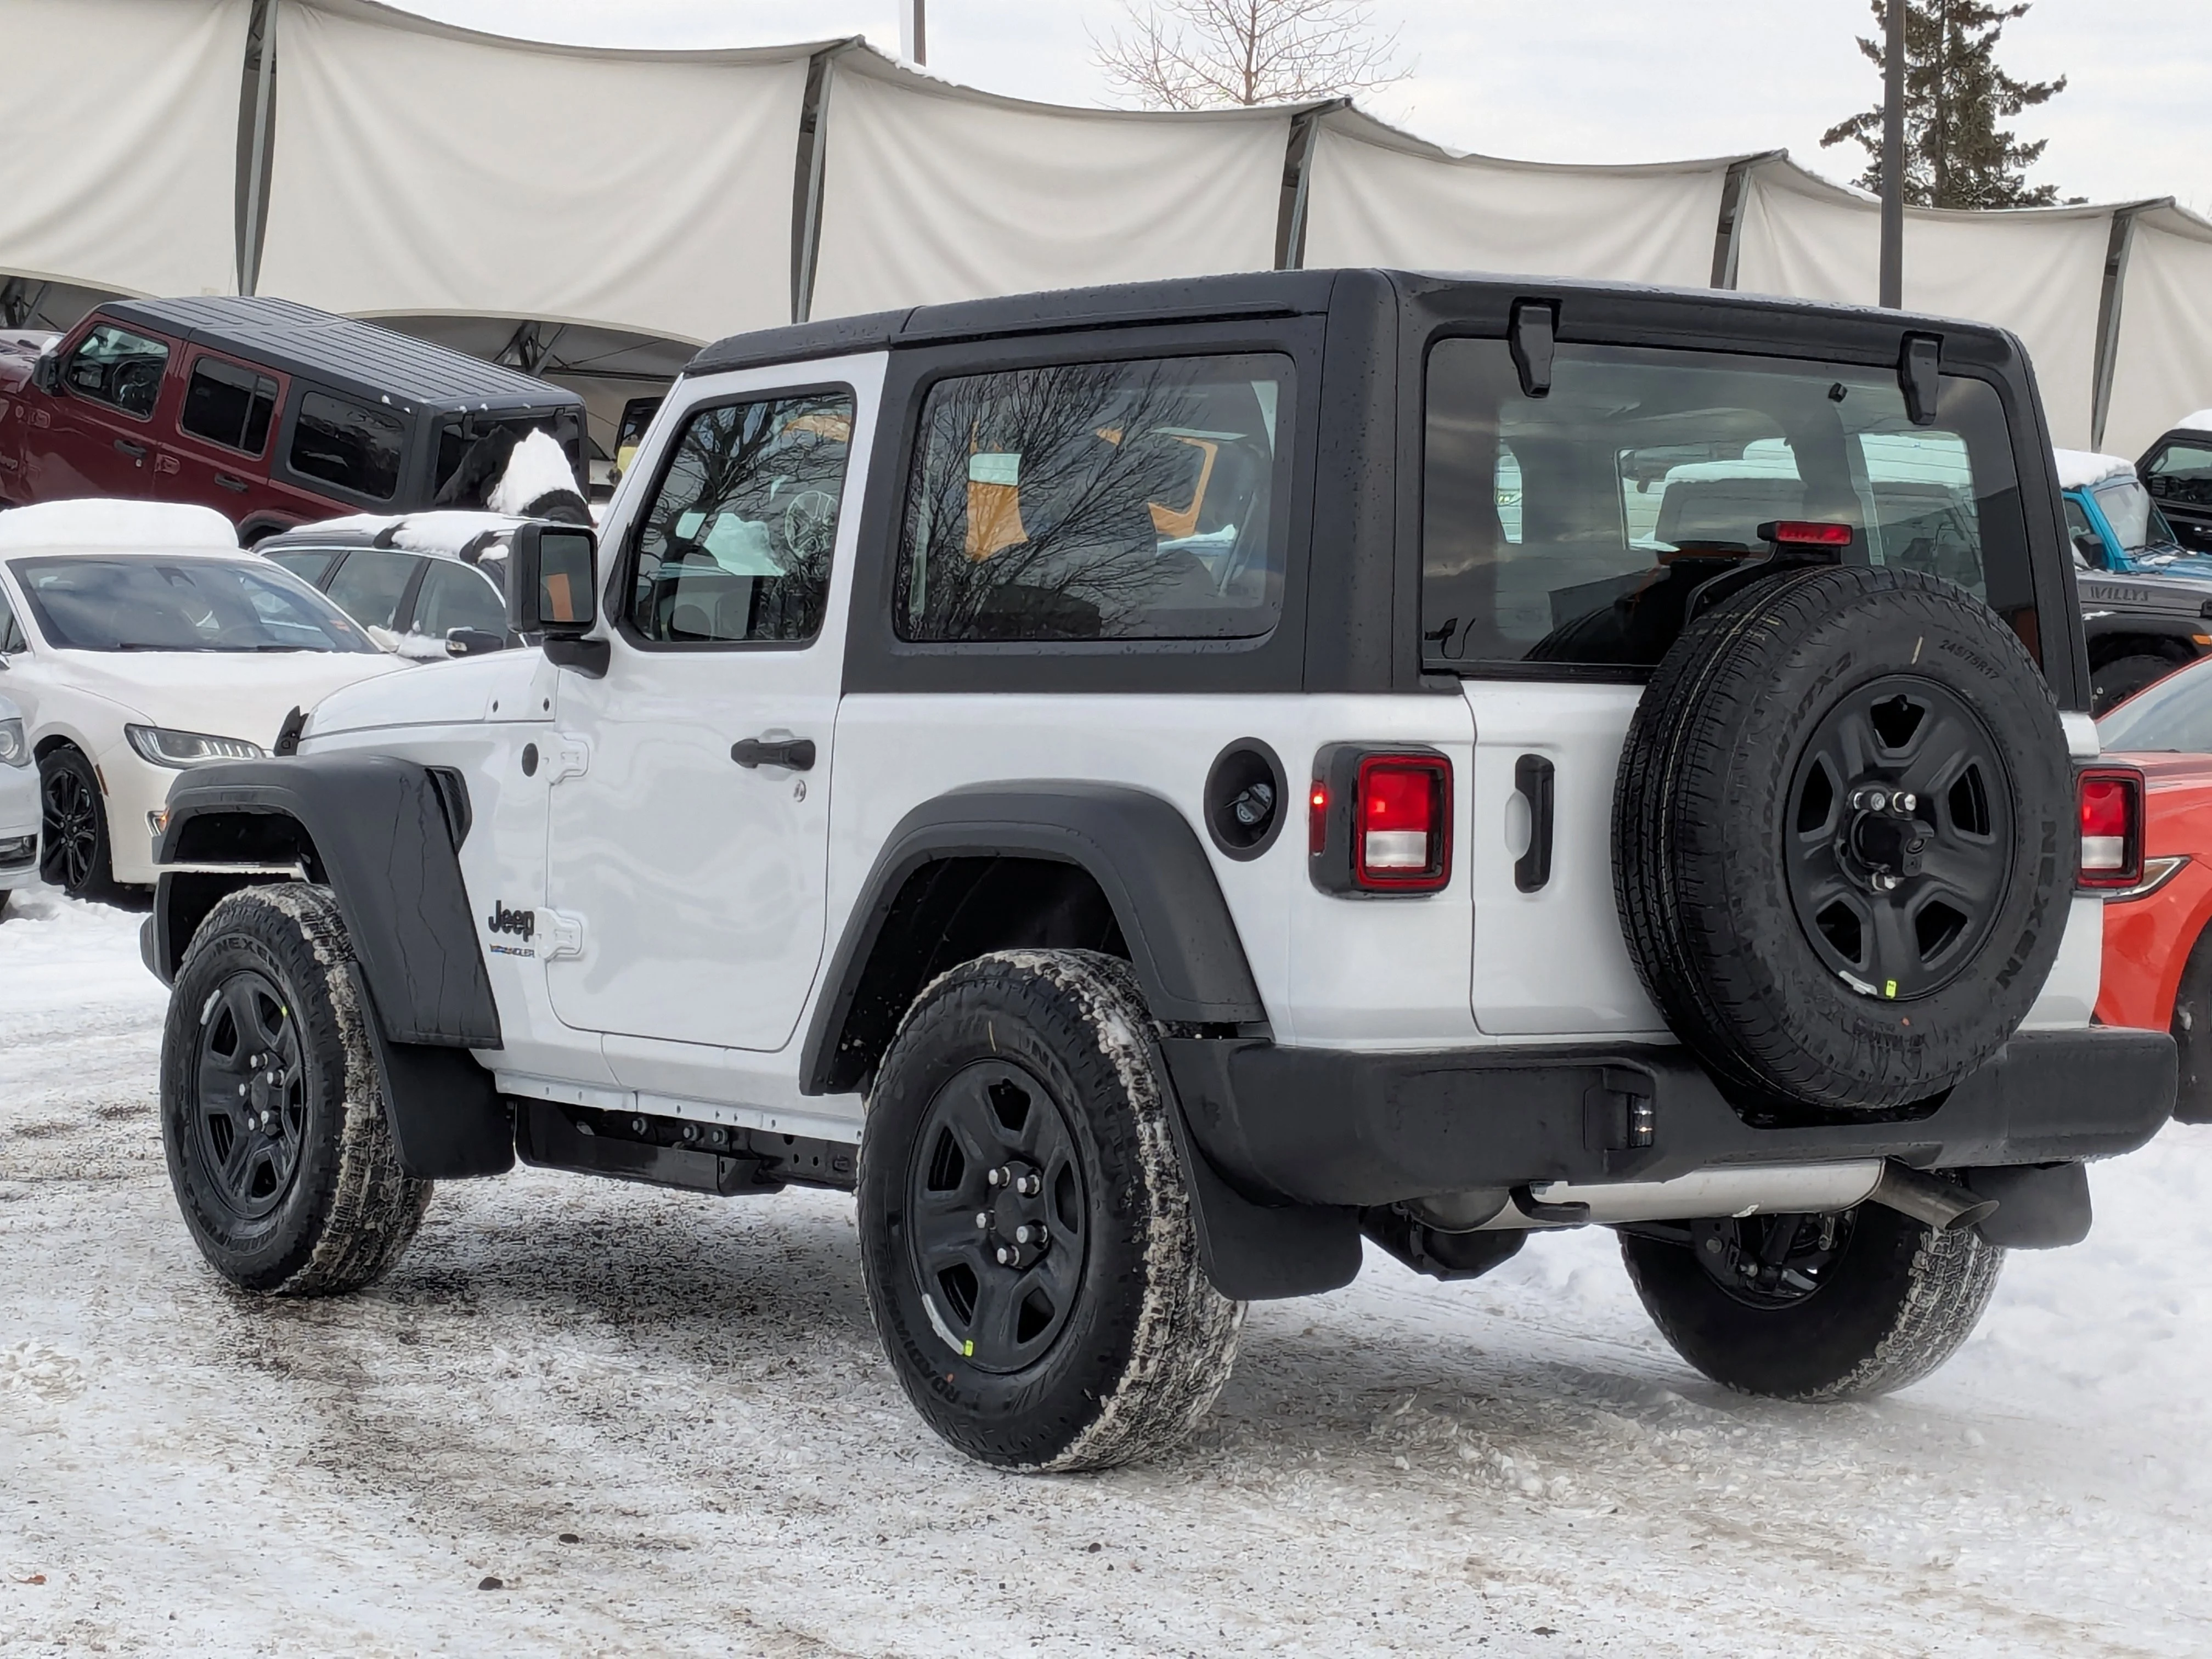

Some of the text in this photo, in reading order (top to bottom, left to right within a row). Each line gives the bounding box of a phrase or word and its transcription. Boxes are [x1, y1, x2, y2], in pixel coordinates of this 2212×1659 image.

[2090, 585, 2153, 601] WILLYS
[488, 900, 534, 943] Jeep
[1995, 821, 2056, 989] NEXEN
